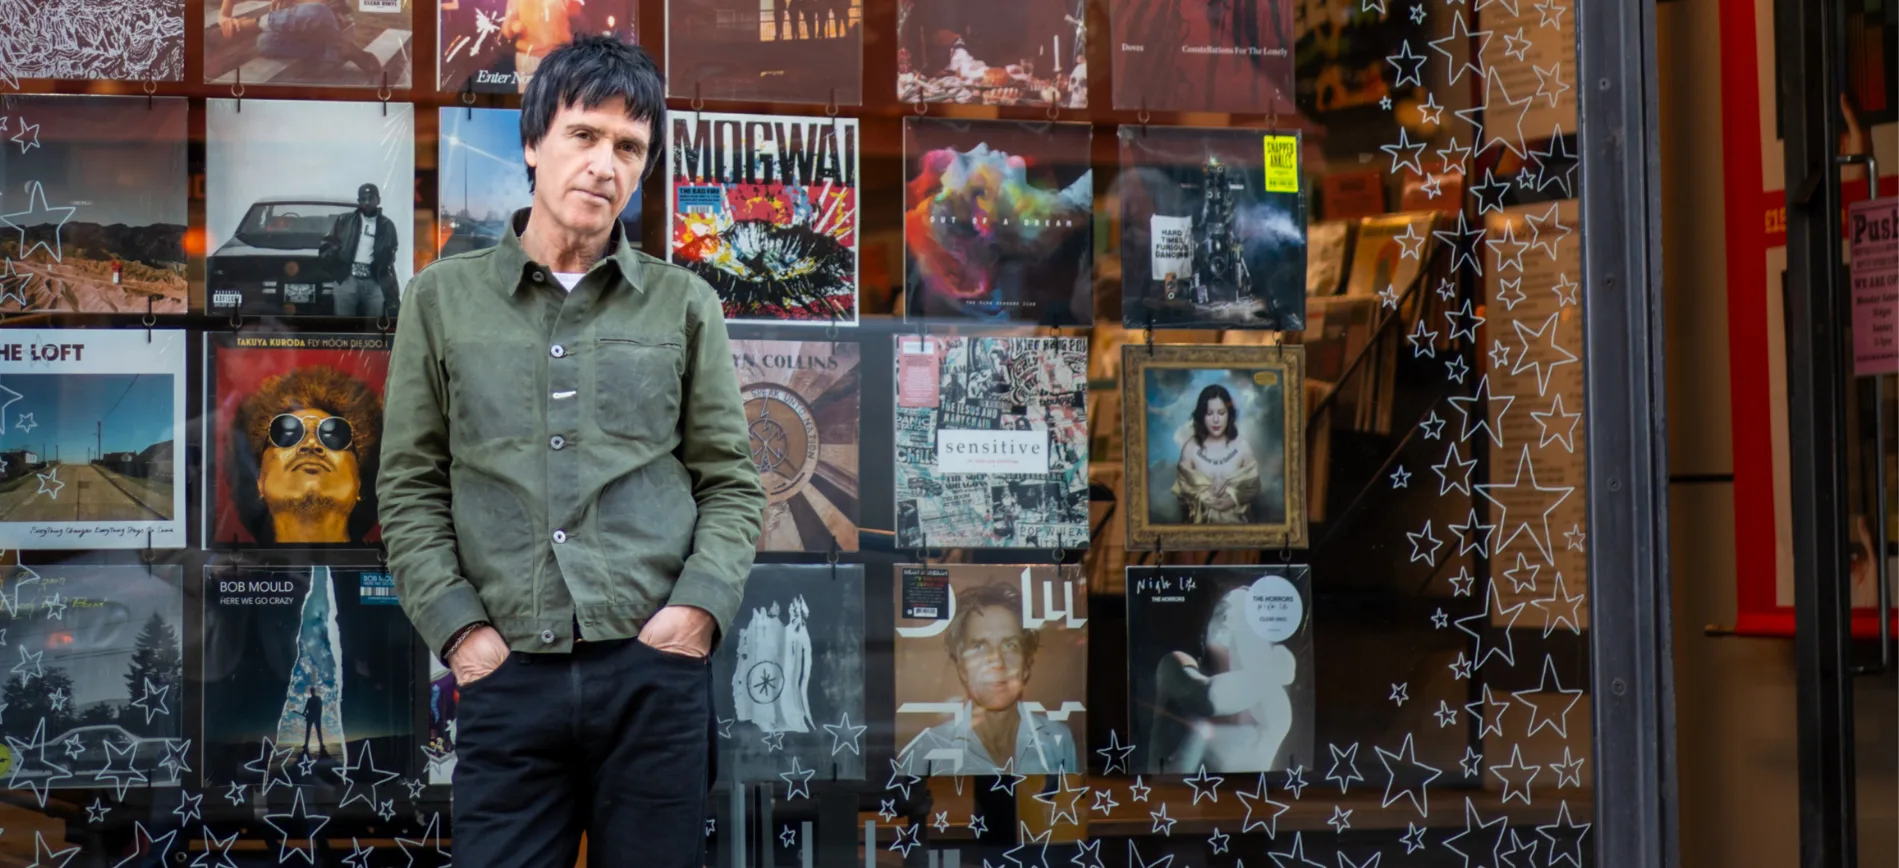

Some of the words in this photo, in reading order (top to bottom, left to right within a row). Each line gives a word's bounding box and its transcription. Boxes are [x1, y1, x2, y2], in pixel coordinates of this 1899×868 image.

[1122, 43, 1144, 52] Doves
[1182, 45, 1234, 55] Constellations
[1235, 46, 1247, 55] For
[1249, 47, 1262, 55] The
[1263, 48, 1288, 58] Lonely
[476, 70, 511, 84] Enter
[511, 71, 533, 84] No
[673, 118, 855, 187] MOGWAI
[930, 216, 956, 224] OUT
[972, 217, 988, 225] OF
[1023, 219, 1072, 227] DREAM
[1161, 229, 1183, 237] HARD
[236, 338, 267, 348] TAKUYA
[269, 338, 305, 348] KURODA
[307, 339, 320, 347] FLY
[0, 344, 22, 361] HE
[31, 343, 85, 361] LOFT
[732, 353, 755, 368] YN
[762, 354, 838, 370] COLLINS
[803, 417, 817, 460] NATION
[945, 439, 1041, 455] sensitive
[220, 581, 246, 593] BOB
[248, 581, 294, 593] MOULD
[220, 597, 240, 605] HERE
[241, 597, 253, 605] WE
[254, 597, 268, 605] GO
[269, 597, 294, 605] CRAZY
